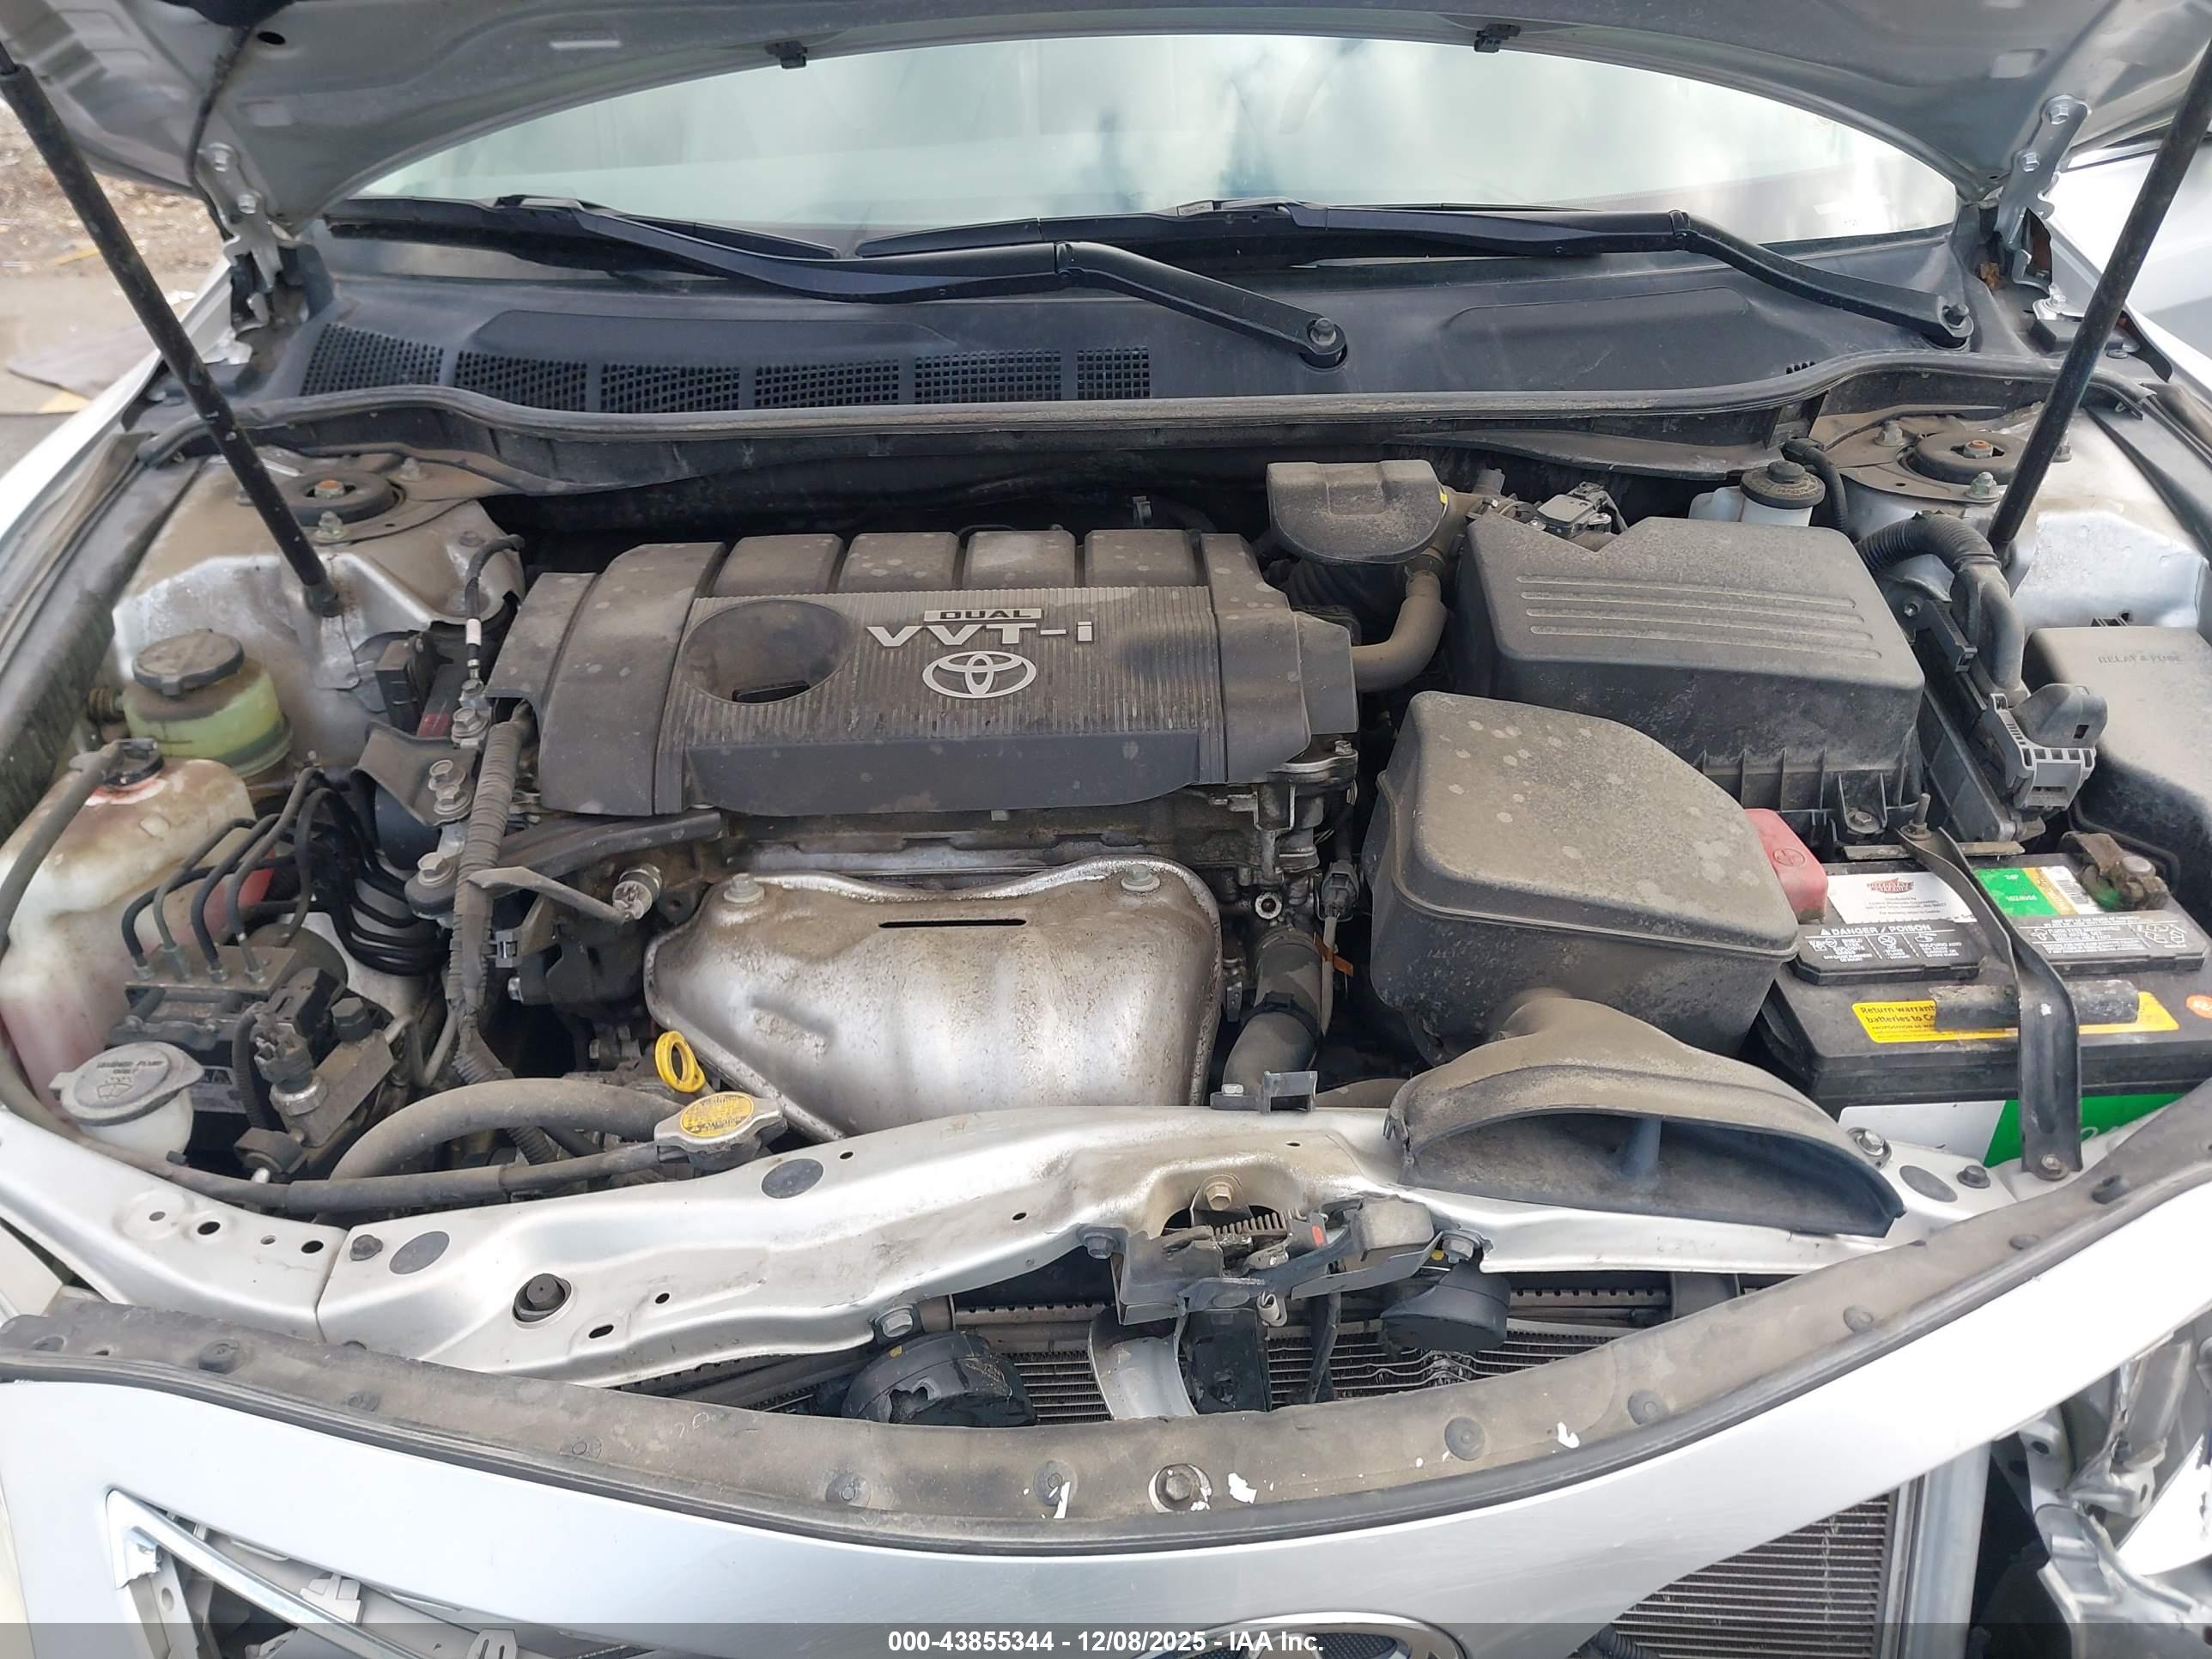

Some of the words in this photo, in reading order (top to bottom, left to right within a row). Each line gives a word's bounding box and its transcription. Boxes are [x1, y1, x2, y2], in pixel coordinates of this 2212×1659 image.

[939, 610, 1031, 619] DUAL
[866, 621, 1093, 647] VVT-i
[1831, 927, 1879, 935] DANGER
[1887, 924, 1932, 933] POISON
[1865, 1015, 1911, 1024] batteries
